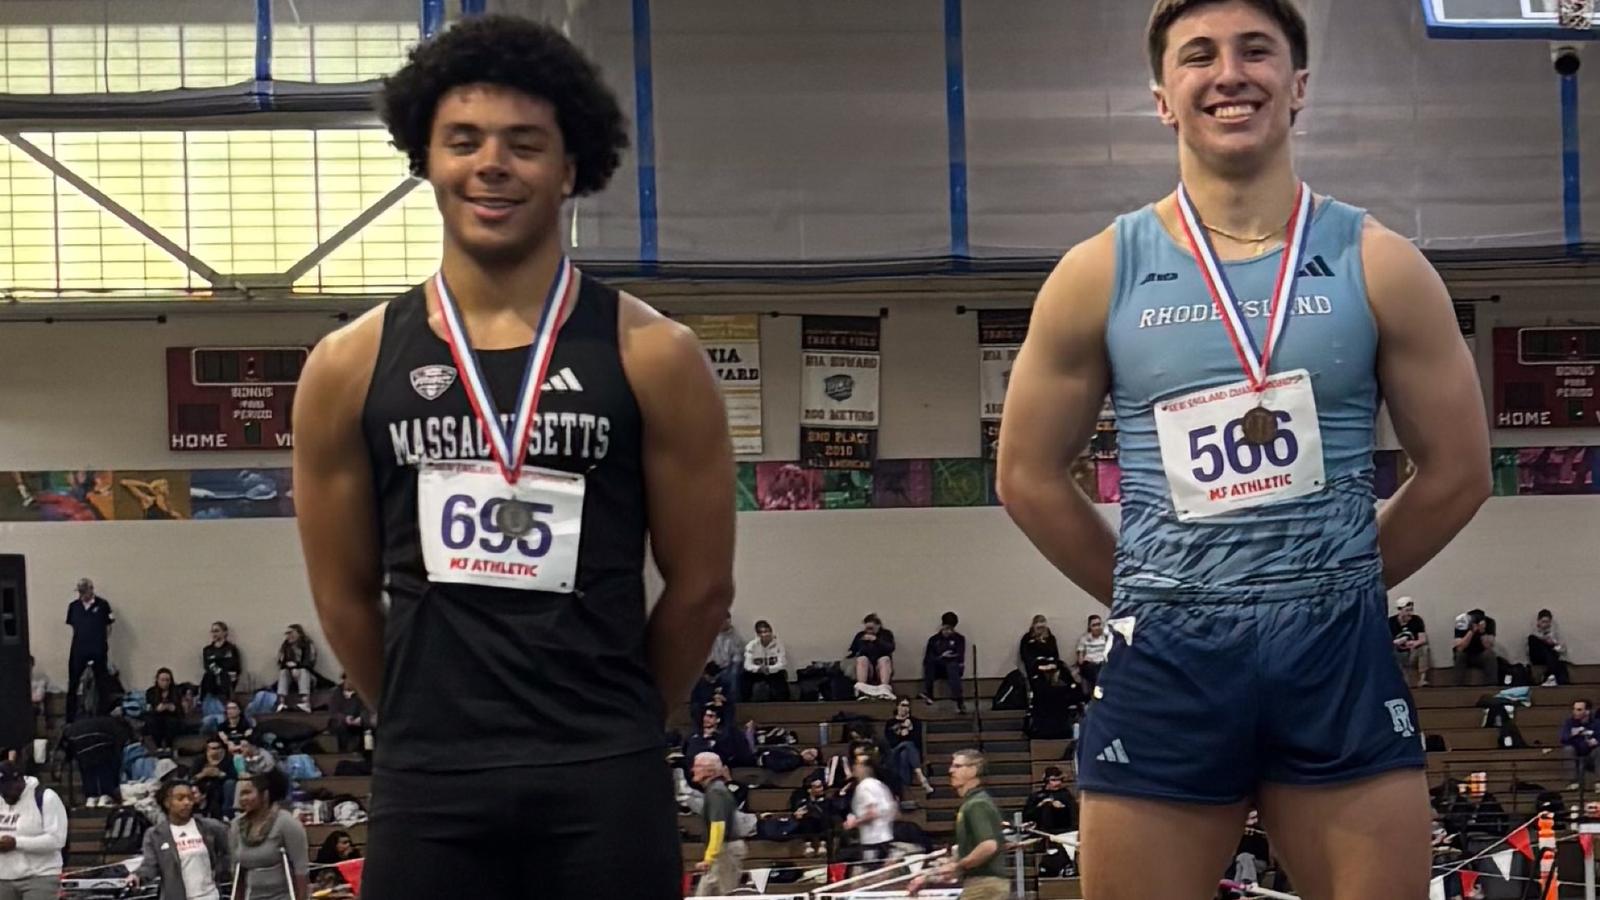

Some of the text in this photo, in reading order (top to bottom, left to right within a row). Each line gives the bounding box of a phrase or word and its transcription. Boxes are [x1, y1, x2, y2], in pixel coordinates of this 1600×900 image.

[231, 387, 274, 398] BONUS
[233, 409, 273, 419] PERIOD
[830, 409, 875, 421] METERS
[1498, 411, 1552, 425] HOME
[172, 433, 229, 448] HOME
[834, 431, 869, 445] PLACE
[825, 445, 853, 456] 2010
[1188, 410, 1299, 483] 566
[1231, 473, 1293, 497] ATHLETIC
[441, 493, 554, 558] 695
[471, 559, 539, 577] ATHLETIC
